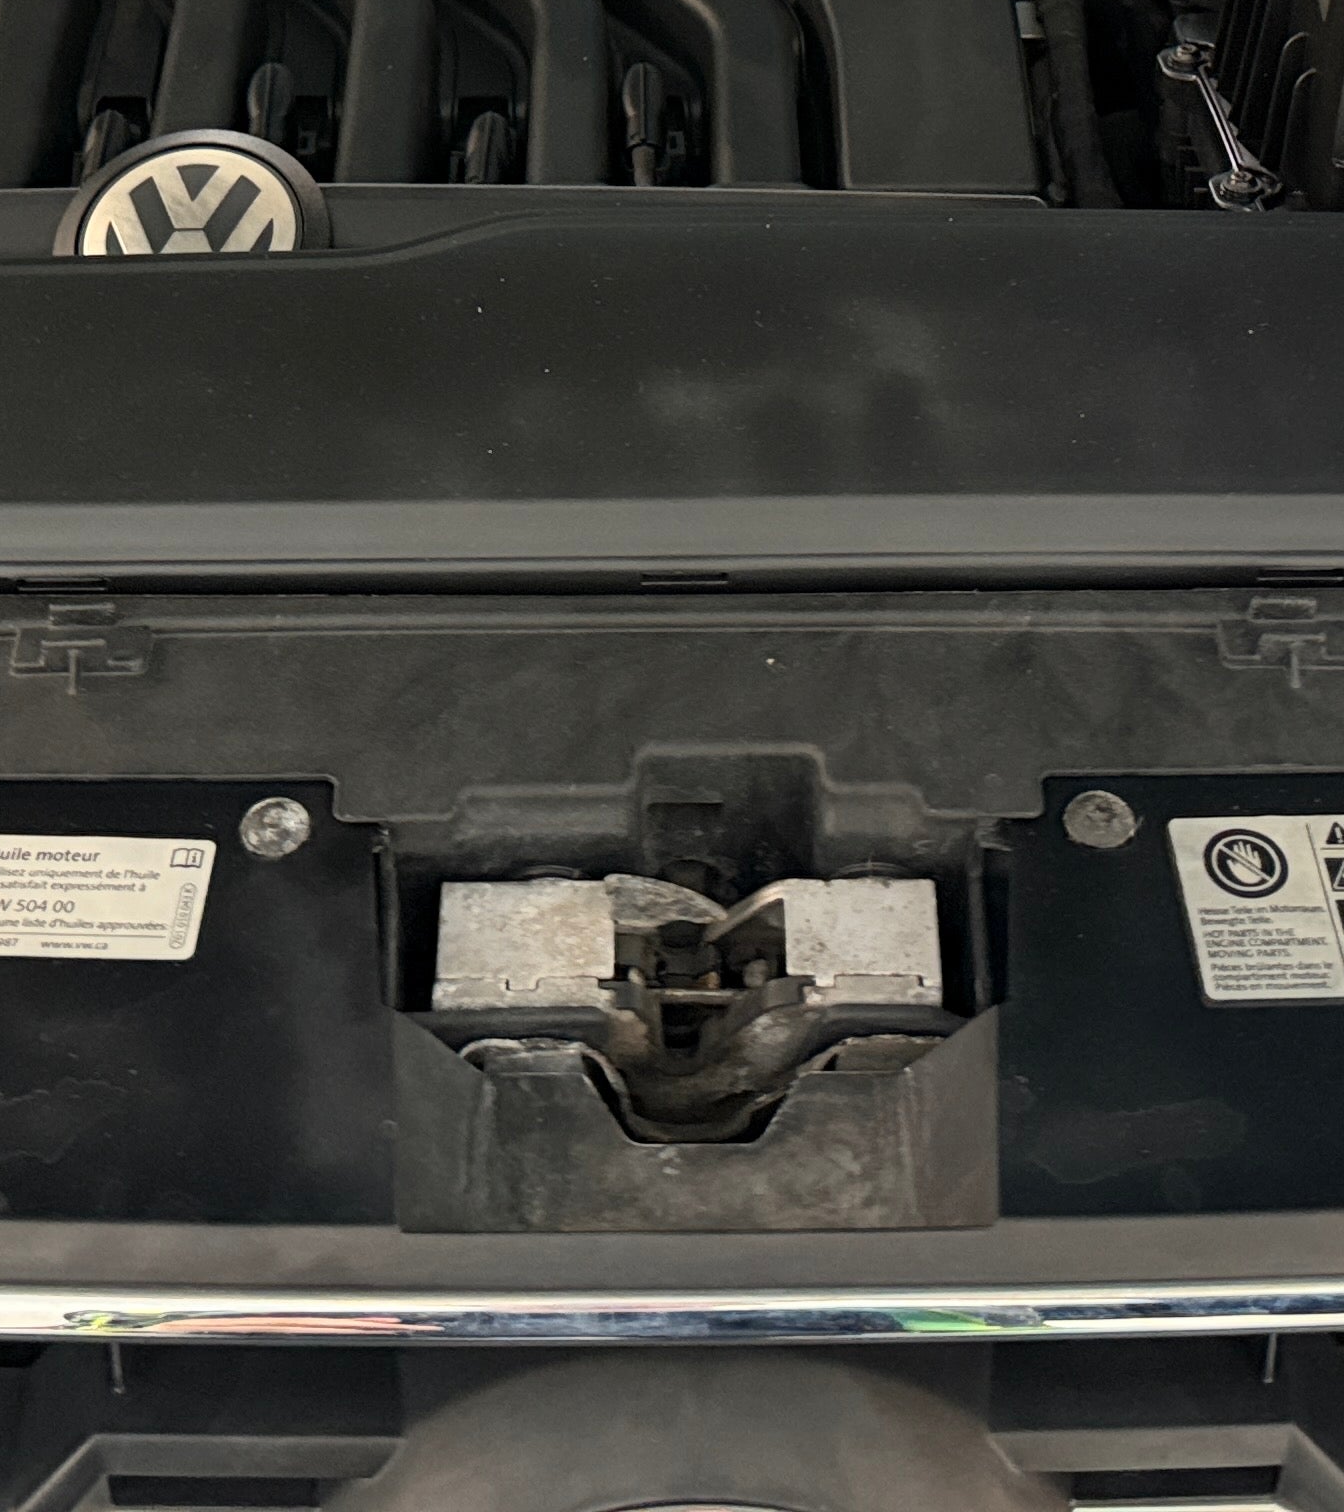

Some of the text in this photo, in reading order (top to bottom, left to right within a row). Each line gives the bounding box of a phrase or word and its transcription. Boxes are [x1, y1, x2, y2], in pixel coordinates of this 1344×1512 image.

[35, 850, 101, 863] moteur
[105, 869, 122, 879] de
[16, 899, 48, 912] 504
[52, 900, 76, 913] 00
